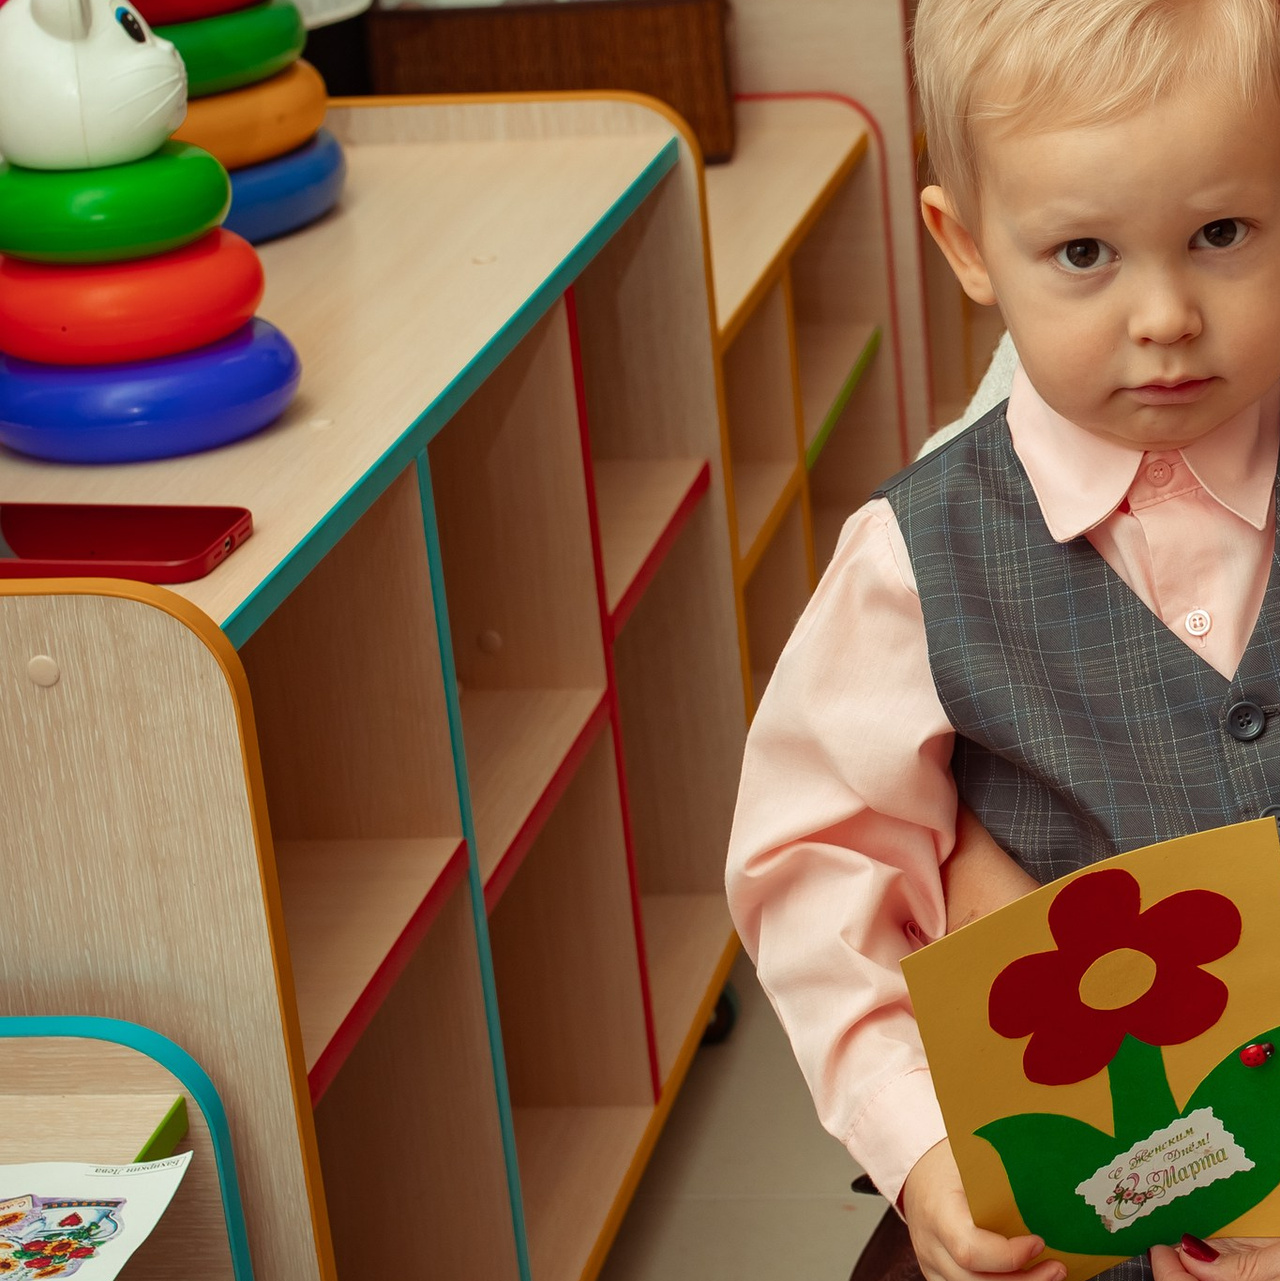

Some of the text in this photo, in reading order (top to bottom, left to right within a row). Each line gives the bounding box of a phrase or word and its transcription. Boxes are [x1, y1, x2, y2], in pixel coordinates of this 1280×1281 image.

[1108, 1127, 1194, 1180] С Женским
[1146, 1147, 1228, 1198] Марта
